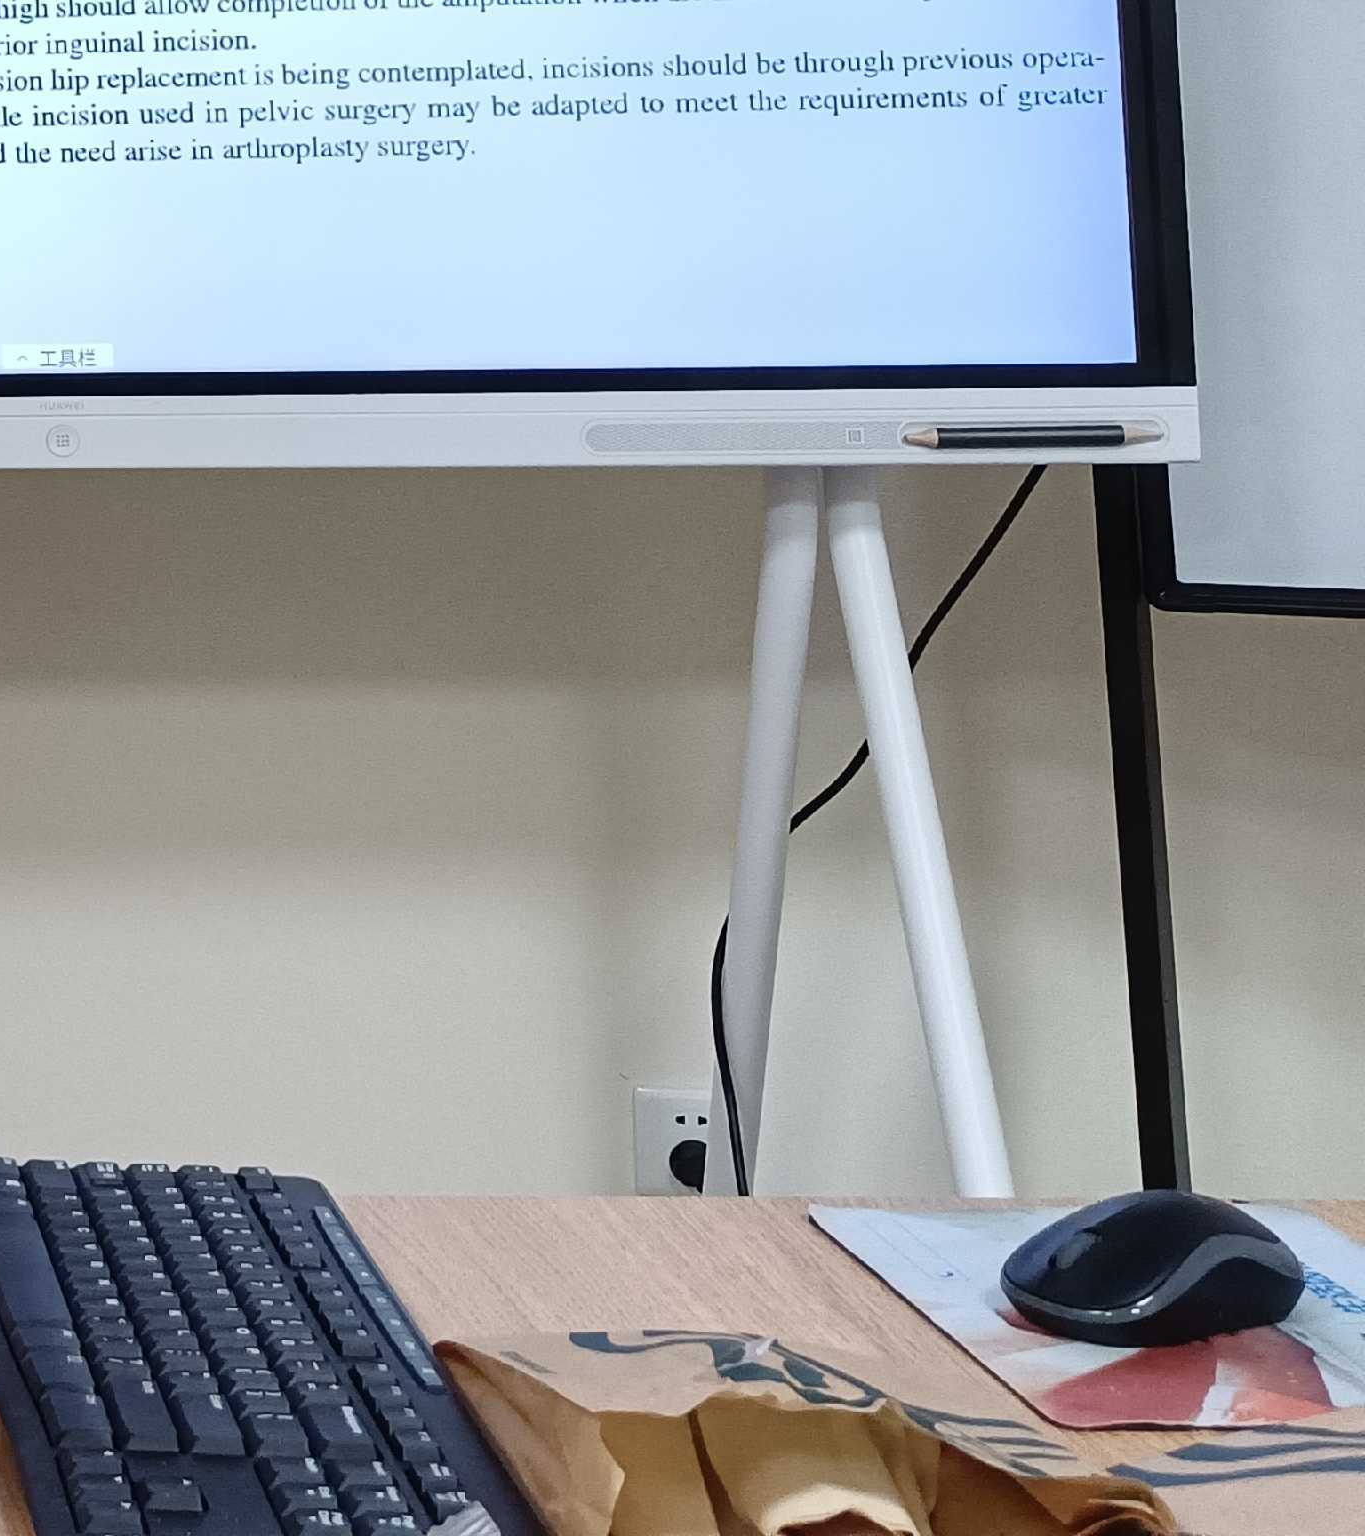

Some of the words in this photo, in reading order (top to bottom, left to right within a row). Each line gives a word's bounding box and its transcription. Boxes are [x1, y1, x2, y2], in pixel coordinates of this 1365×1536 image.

[45, 30, 144, 60] inguinal
[152, 28, 256, 53] incision.
[15, 142, 51, 164] the
[59, 140, 115, 163] need
[124, 139, 181, 162] arise
[191, 138, 213, 160] in
[222, 136, 369, 165] arthroplasty
[376, 139, 475, 162] surgery.
[39, 348, 97, 368] 工具栏
